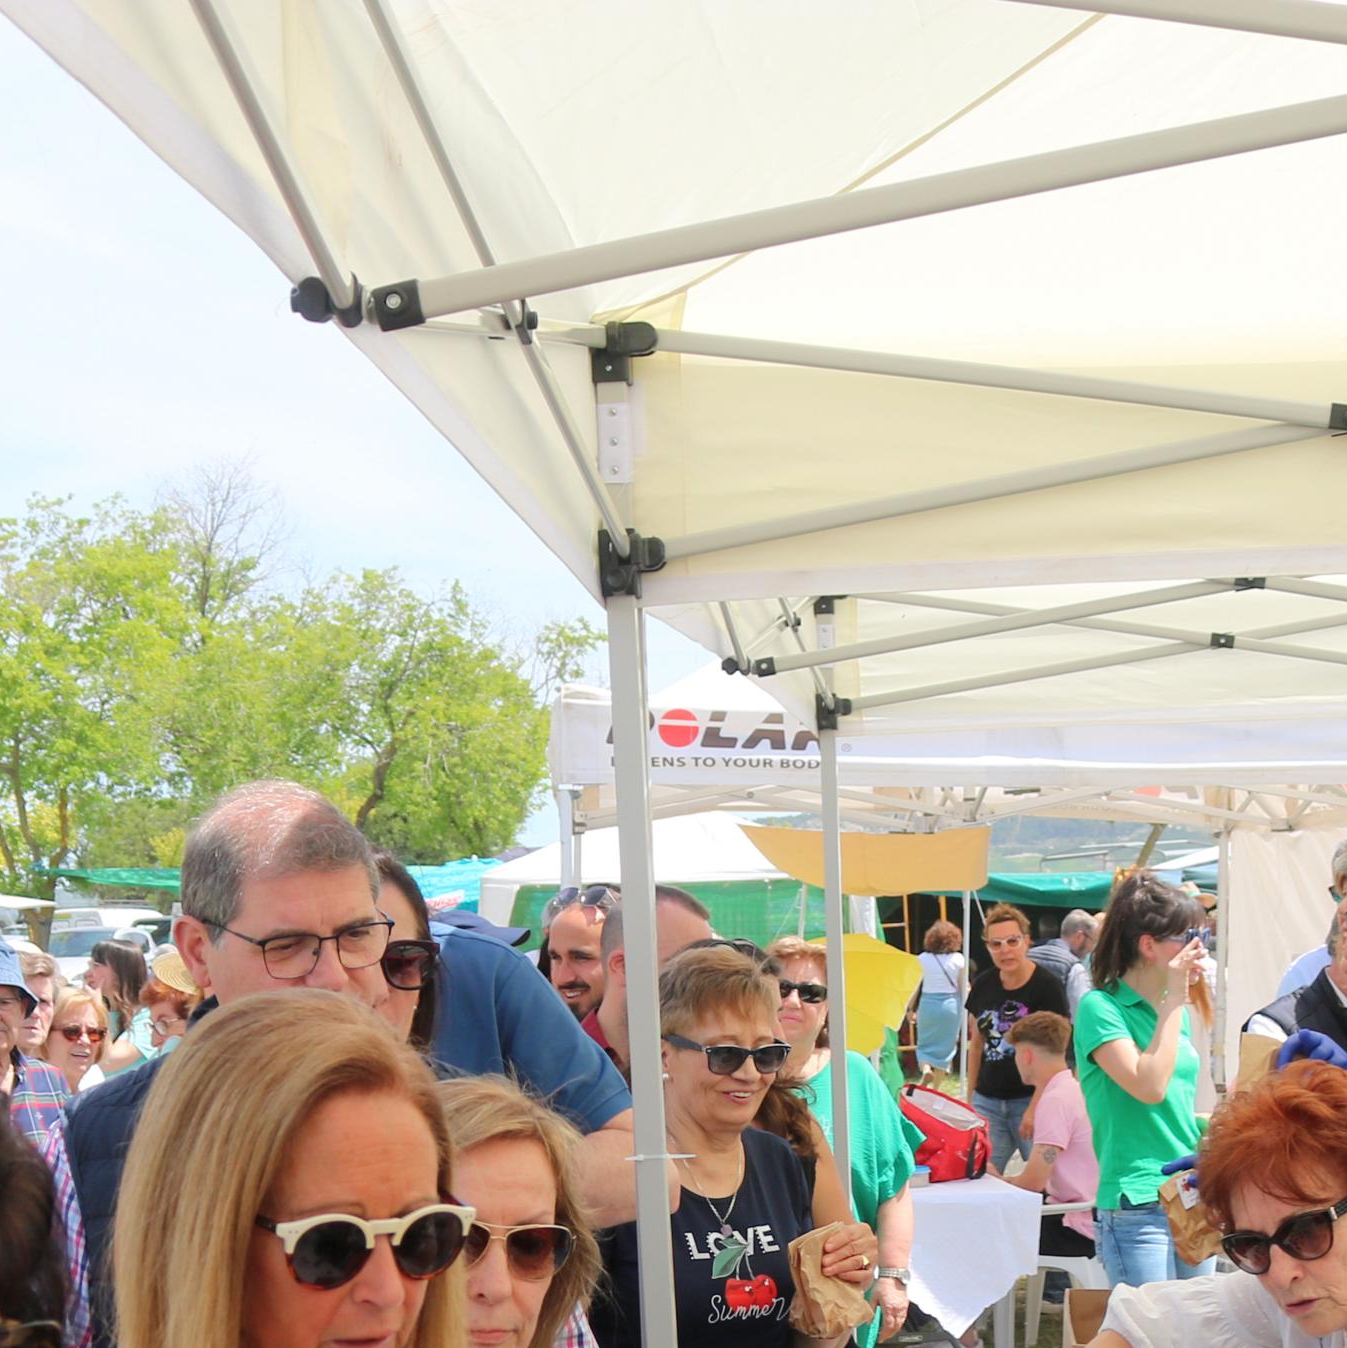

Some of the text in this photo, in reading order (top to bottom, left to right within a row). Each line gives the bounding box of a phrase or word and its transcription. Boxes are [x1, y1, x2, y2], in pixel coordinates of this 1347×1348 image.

[606, 708, 821, 751] OLA
[691, 757, 715, 768] TO
[722, 757, 773, 769] YOUR
[780, 759, 820, 769] BOD
[684, 1225, 780, 1260] LOVE
[708, 1295, 793, 1323] Summer
